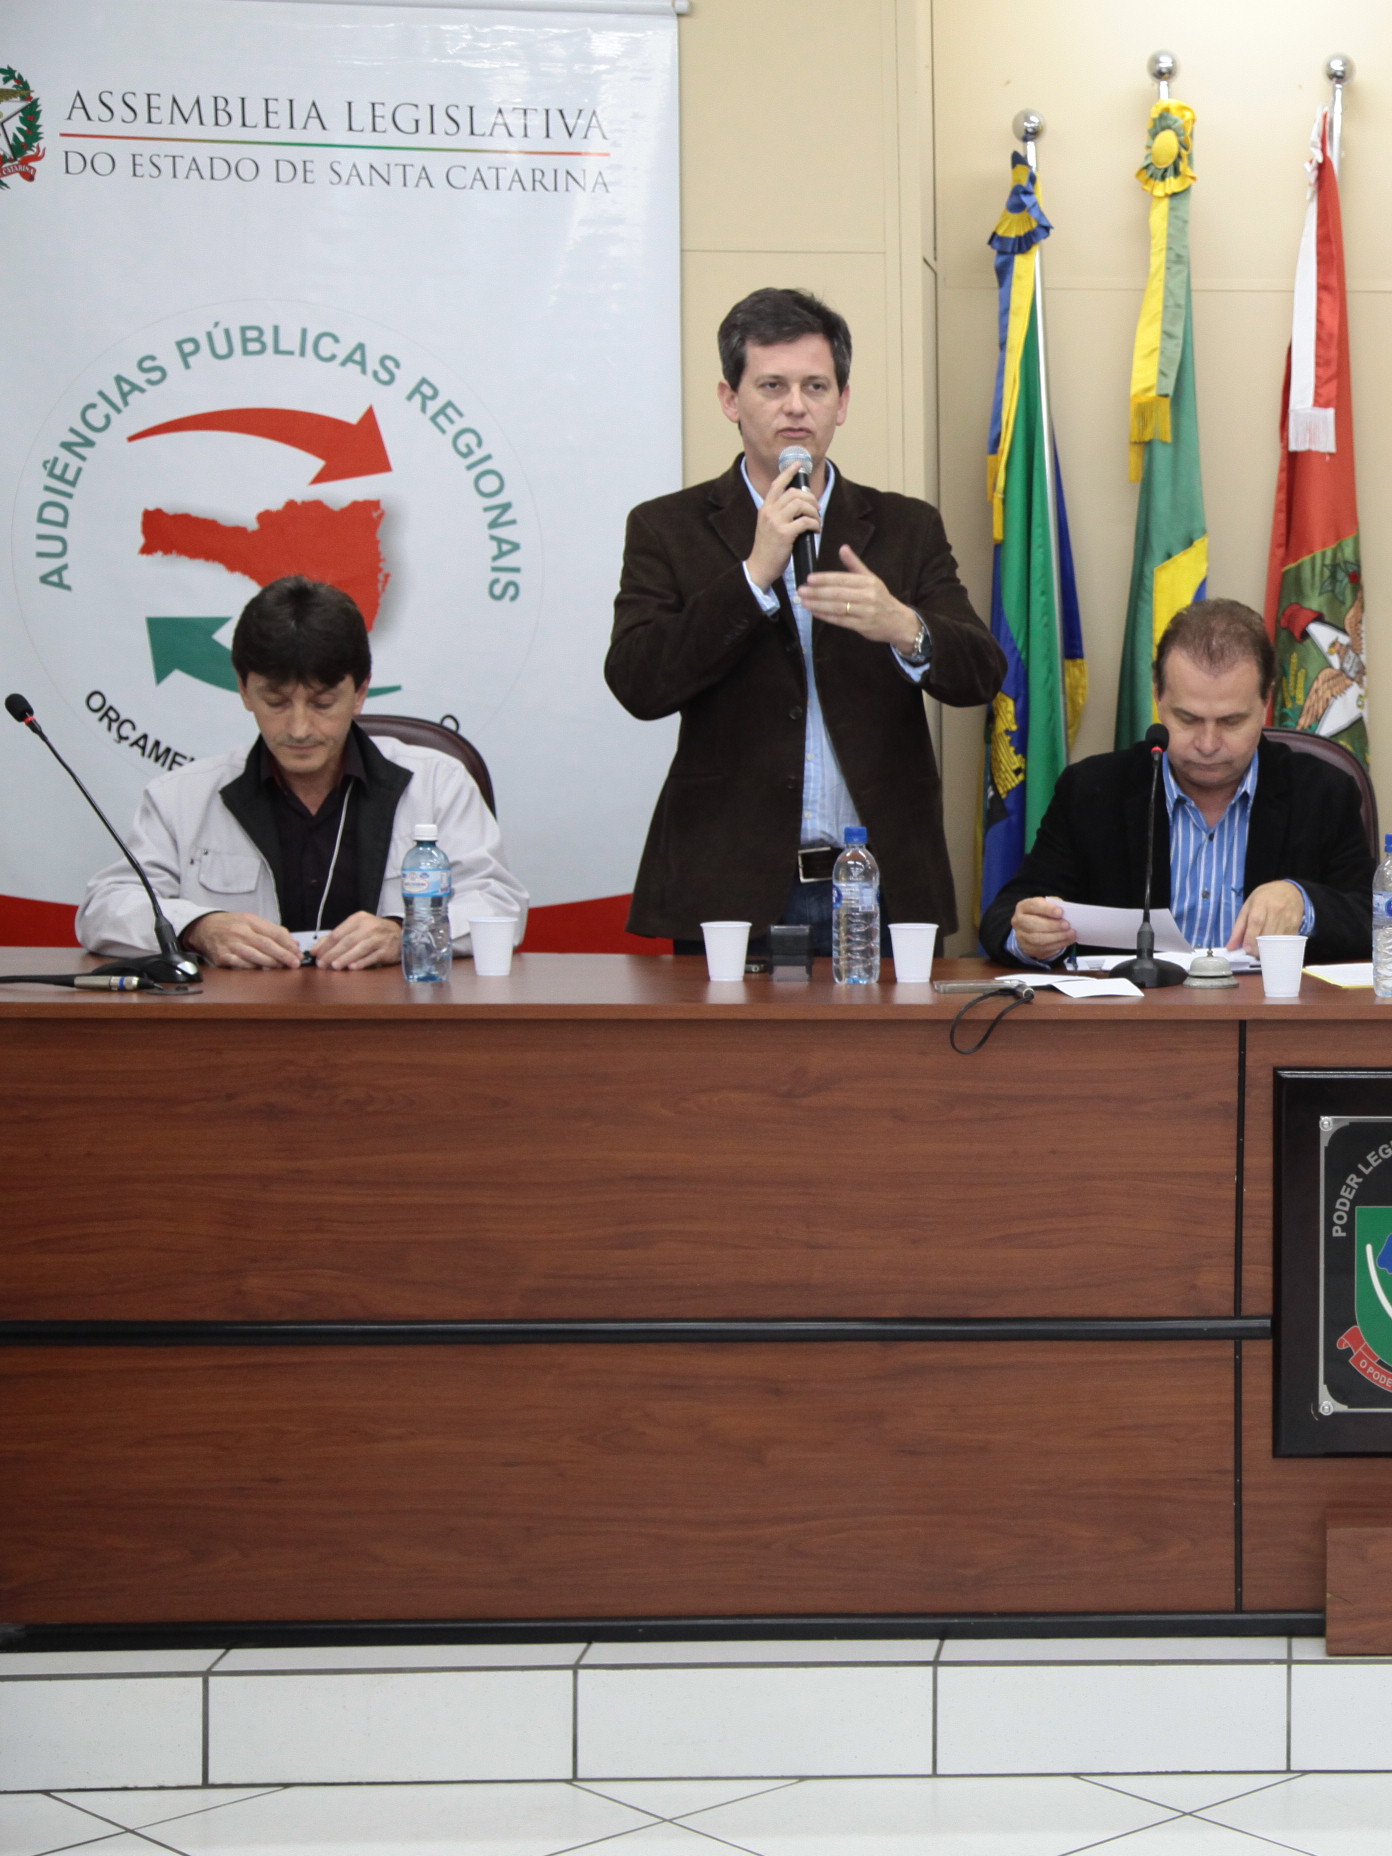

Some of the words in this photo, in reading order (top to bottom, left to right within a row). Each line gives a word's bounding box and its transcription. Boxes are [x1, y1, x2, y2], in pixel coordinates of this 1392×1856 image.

[65, 89, 329, 132] ASSEMBLEIA
[344, 99, 610, 141] LEGISLATIVA
[63, 150, 116, 176] DO
[130, 152, 260, 184] ESTADO
[274, 157, 316, 185] DE
[328, 160, 435, 190] SANTA
[445, 164, 611, 194] CATARINA
[35, 354, 168, 592] AUDIÊNCIAS
[174, 321, 402, 386] PÚBLICAS
[405, 376, 522, 603] REGIONAIS
[84, 690, 196, 772] ORÇAME
[1332, 1173, 1363, 1237] PODER
[1359, 1359, 1367, 1369] O
